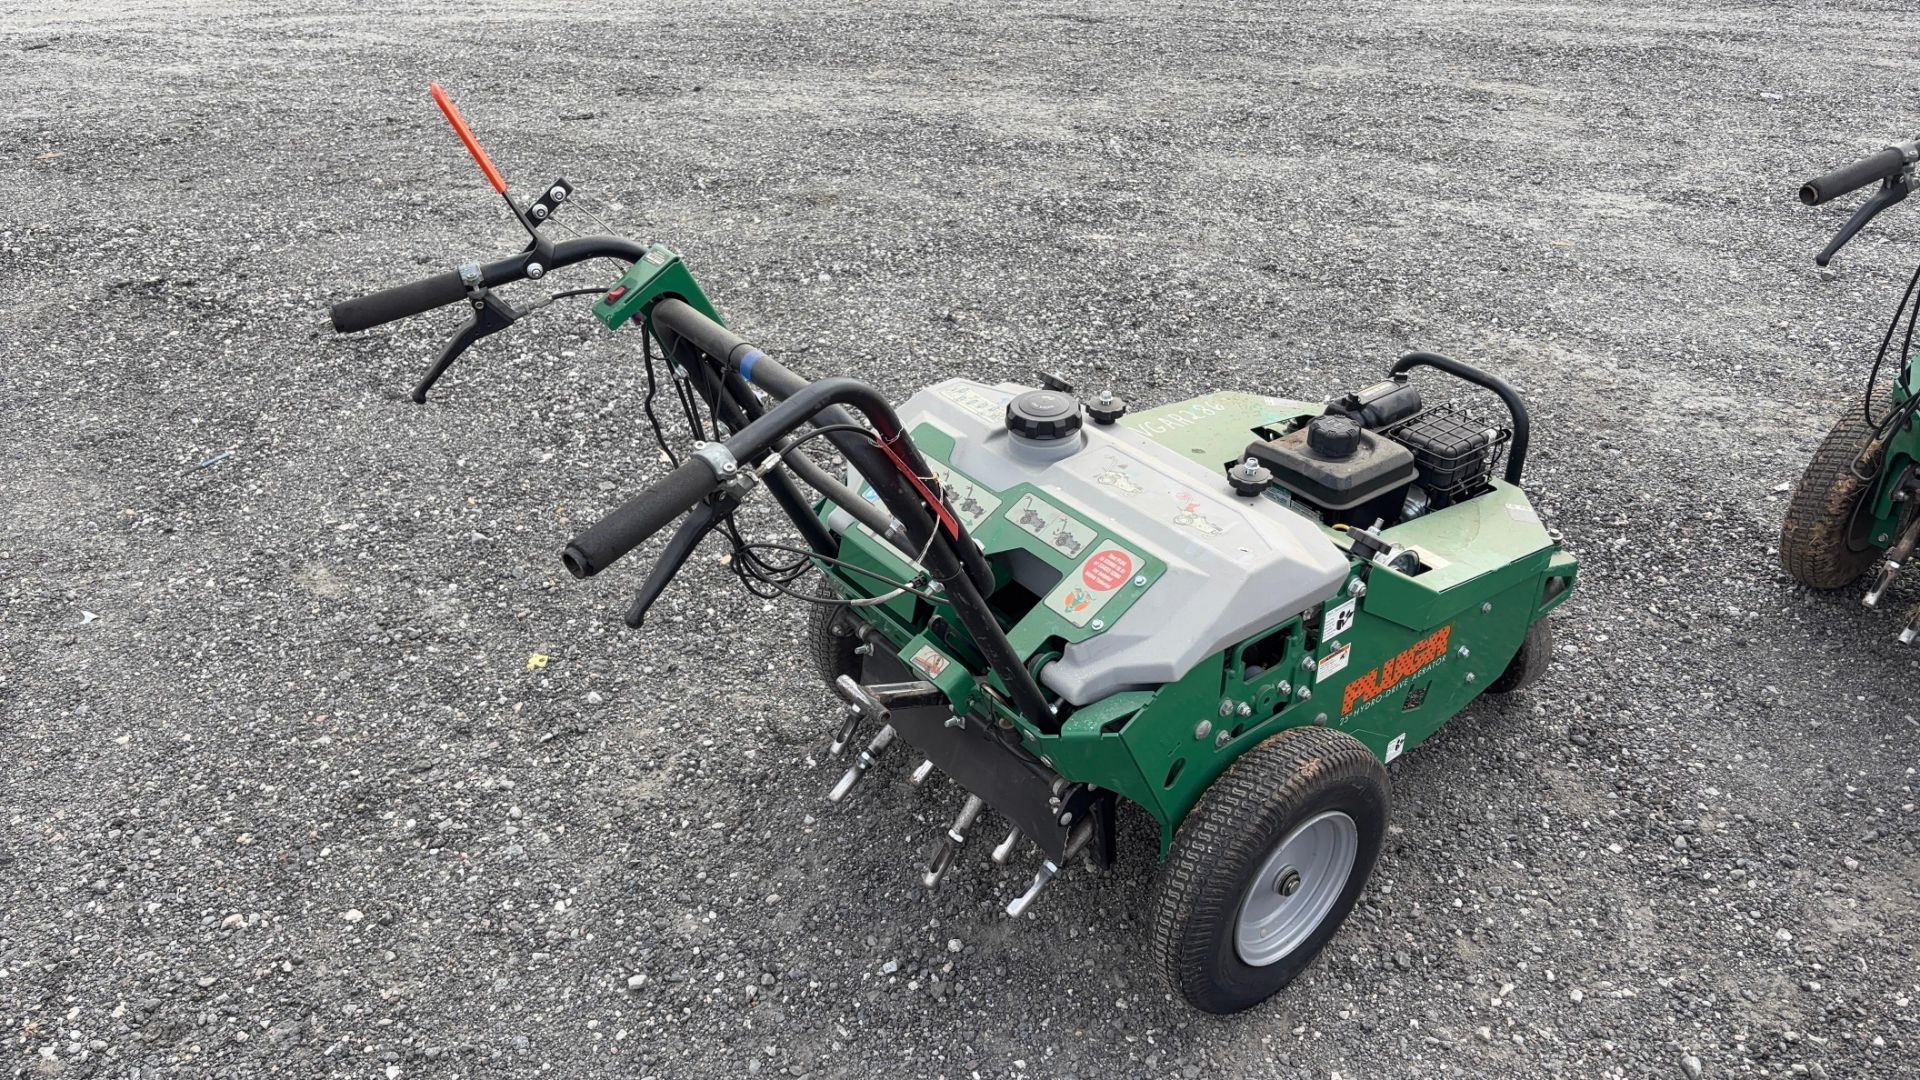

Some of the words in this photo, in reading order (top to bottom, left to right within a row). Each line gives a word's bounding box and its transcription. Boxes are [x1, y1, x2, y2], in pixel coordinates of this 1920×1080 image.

[1341, 625, 1452, 715] PLUGR
[1353, 678, 1408, 717] HYDRO-DRIVE
[1411, 655, 1447, 682] AERATOR
